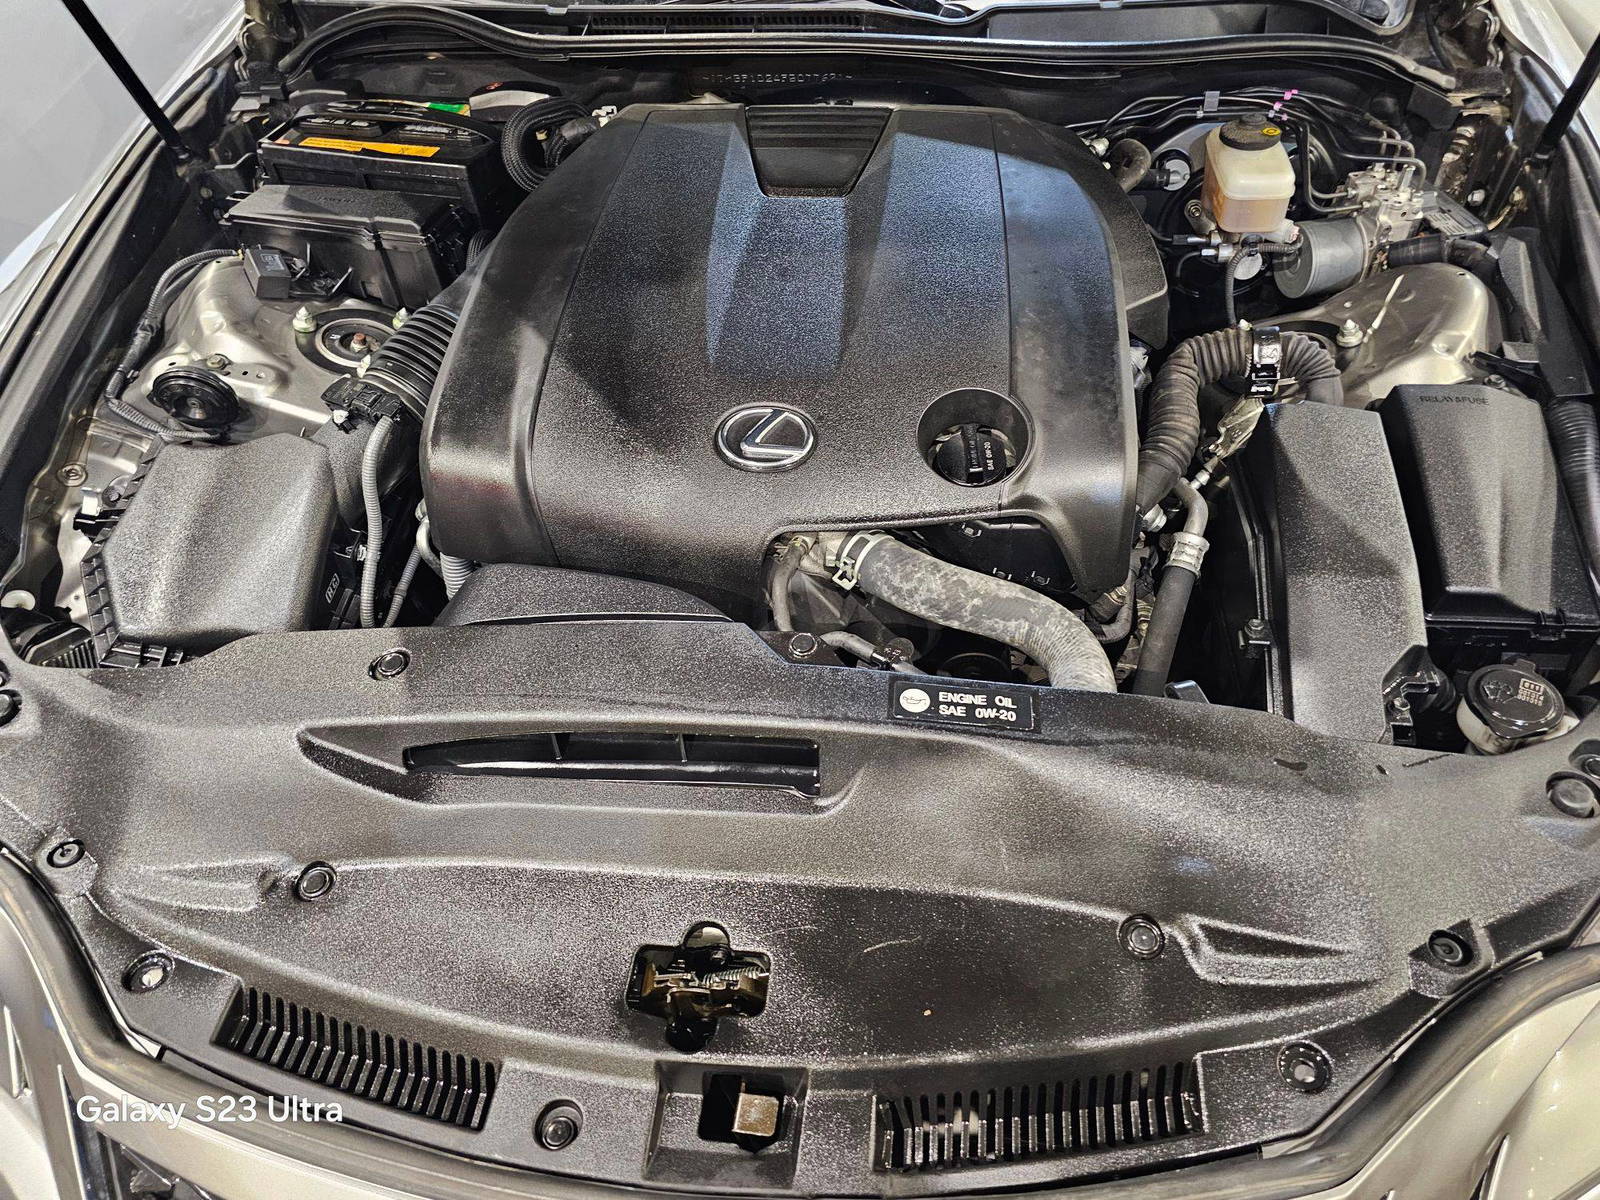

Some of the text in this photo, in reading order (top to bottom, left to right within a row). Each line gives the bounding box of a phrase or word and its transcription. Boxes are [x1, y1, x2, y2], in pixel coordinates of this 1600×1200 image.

[938, 691, 1018, 709] ENGINE OIL
[938, 704, 1017, 722] SAE 0W-20
